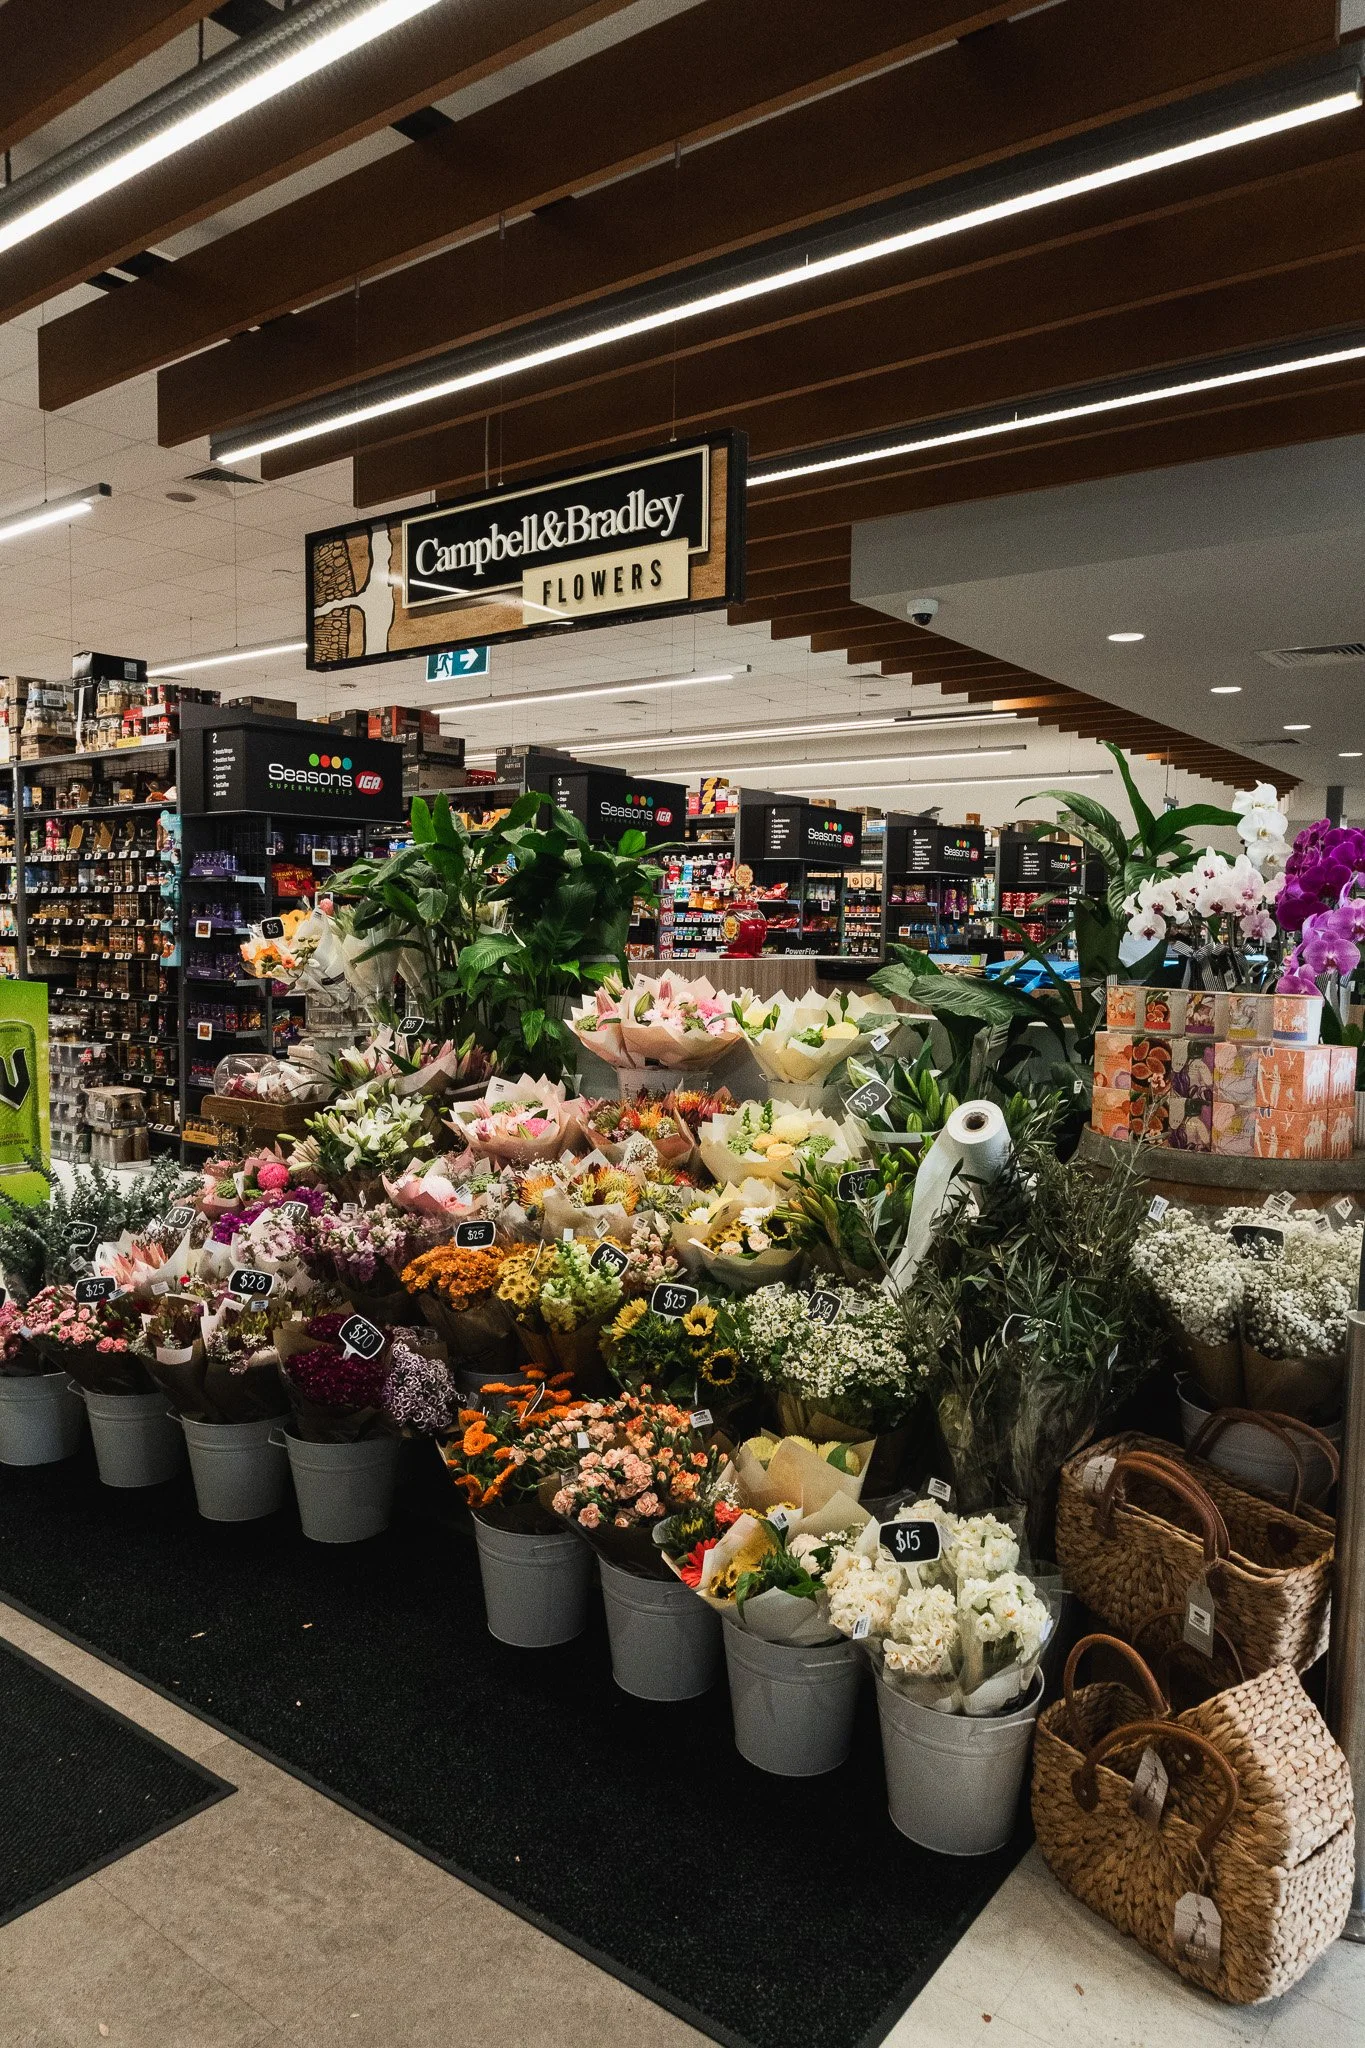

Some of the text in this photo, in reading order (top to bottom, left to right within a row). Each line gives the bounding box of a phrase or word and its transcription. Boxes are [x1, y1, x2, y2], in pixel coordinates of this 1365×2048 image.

[415, 488, 684, 576] Campbell&Bradley
[543, 559, 662, 605] FLOWERS
[212, 732, 218, 744] 2
[268, 763, 382, 790] Seasons IGA
[557, 777, 563, 787] 3
[268, 782, 353, 796] SUPERMARKETS
[600, 801, 672, 823] Seasons IGA
[771, 808, 776, 816] 4
[807, 827, 842, 843] Seasons
[943, 845, 970, 858] Seasons
[266, 923, 279, 935] $25
[403, 1019, 417, 1030] $35
[853, 1088, 880, 1112] $35
[168, 1209, 190, 1224] $35
[465, 1229, 485, 1241] $25
[85, 1282, 106, 1298] $25
[239, 1273, 266, 1291] $28
[663, 1289, 687, 1310] $25
[810, 1294, 833, 1318] $30
[348, 1323, 375, 1349] $20
[895, 1529, 921, 1553] $15
